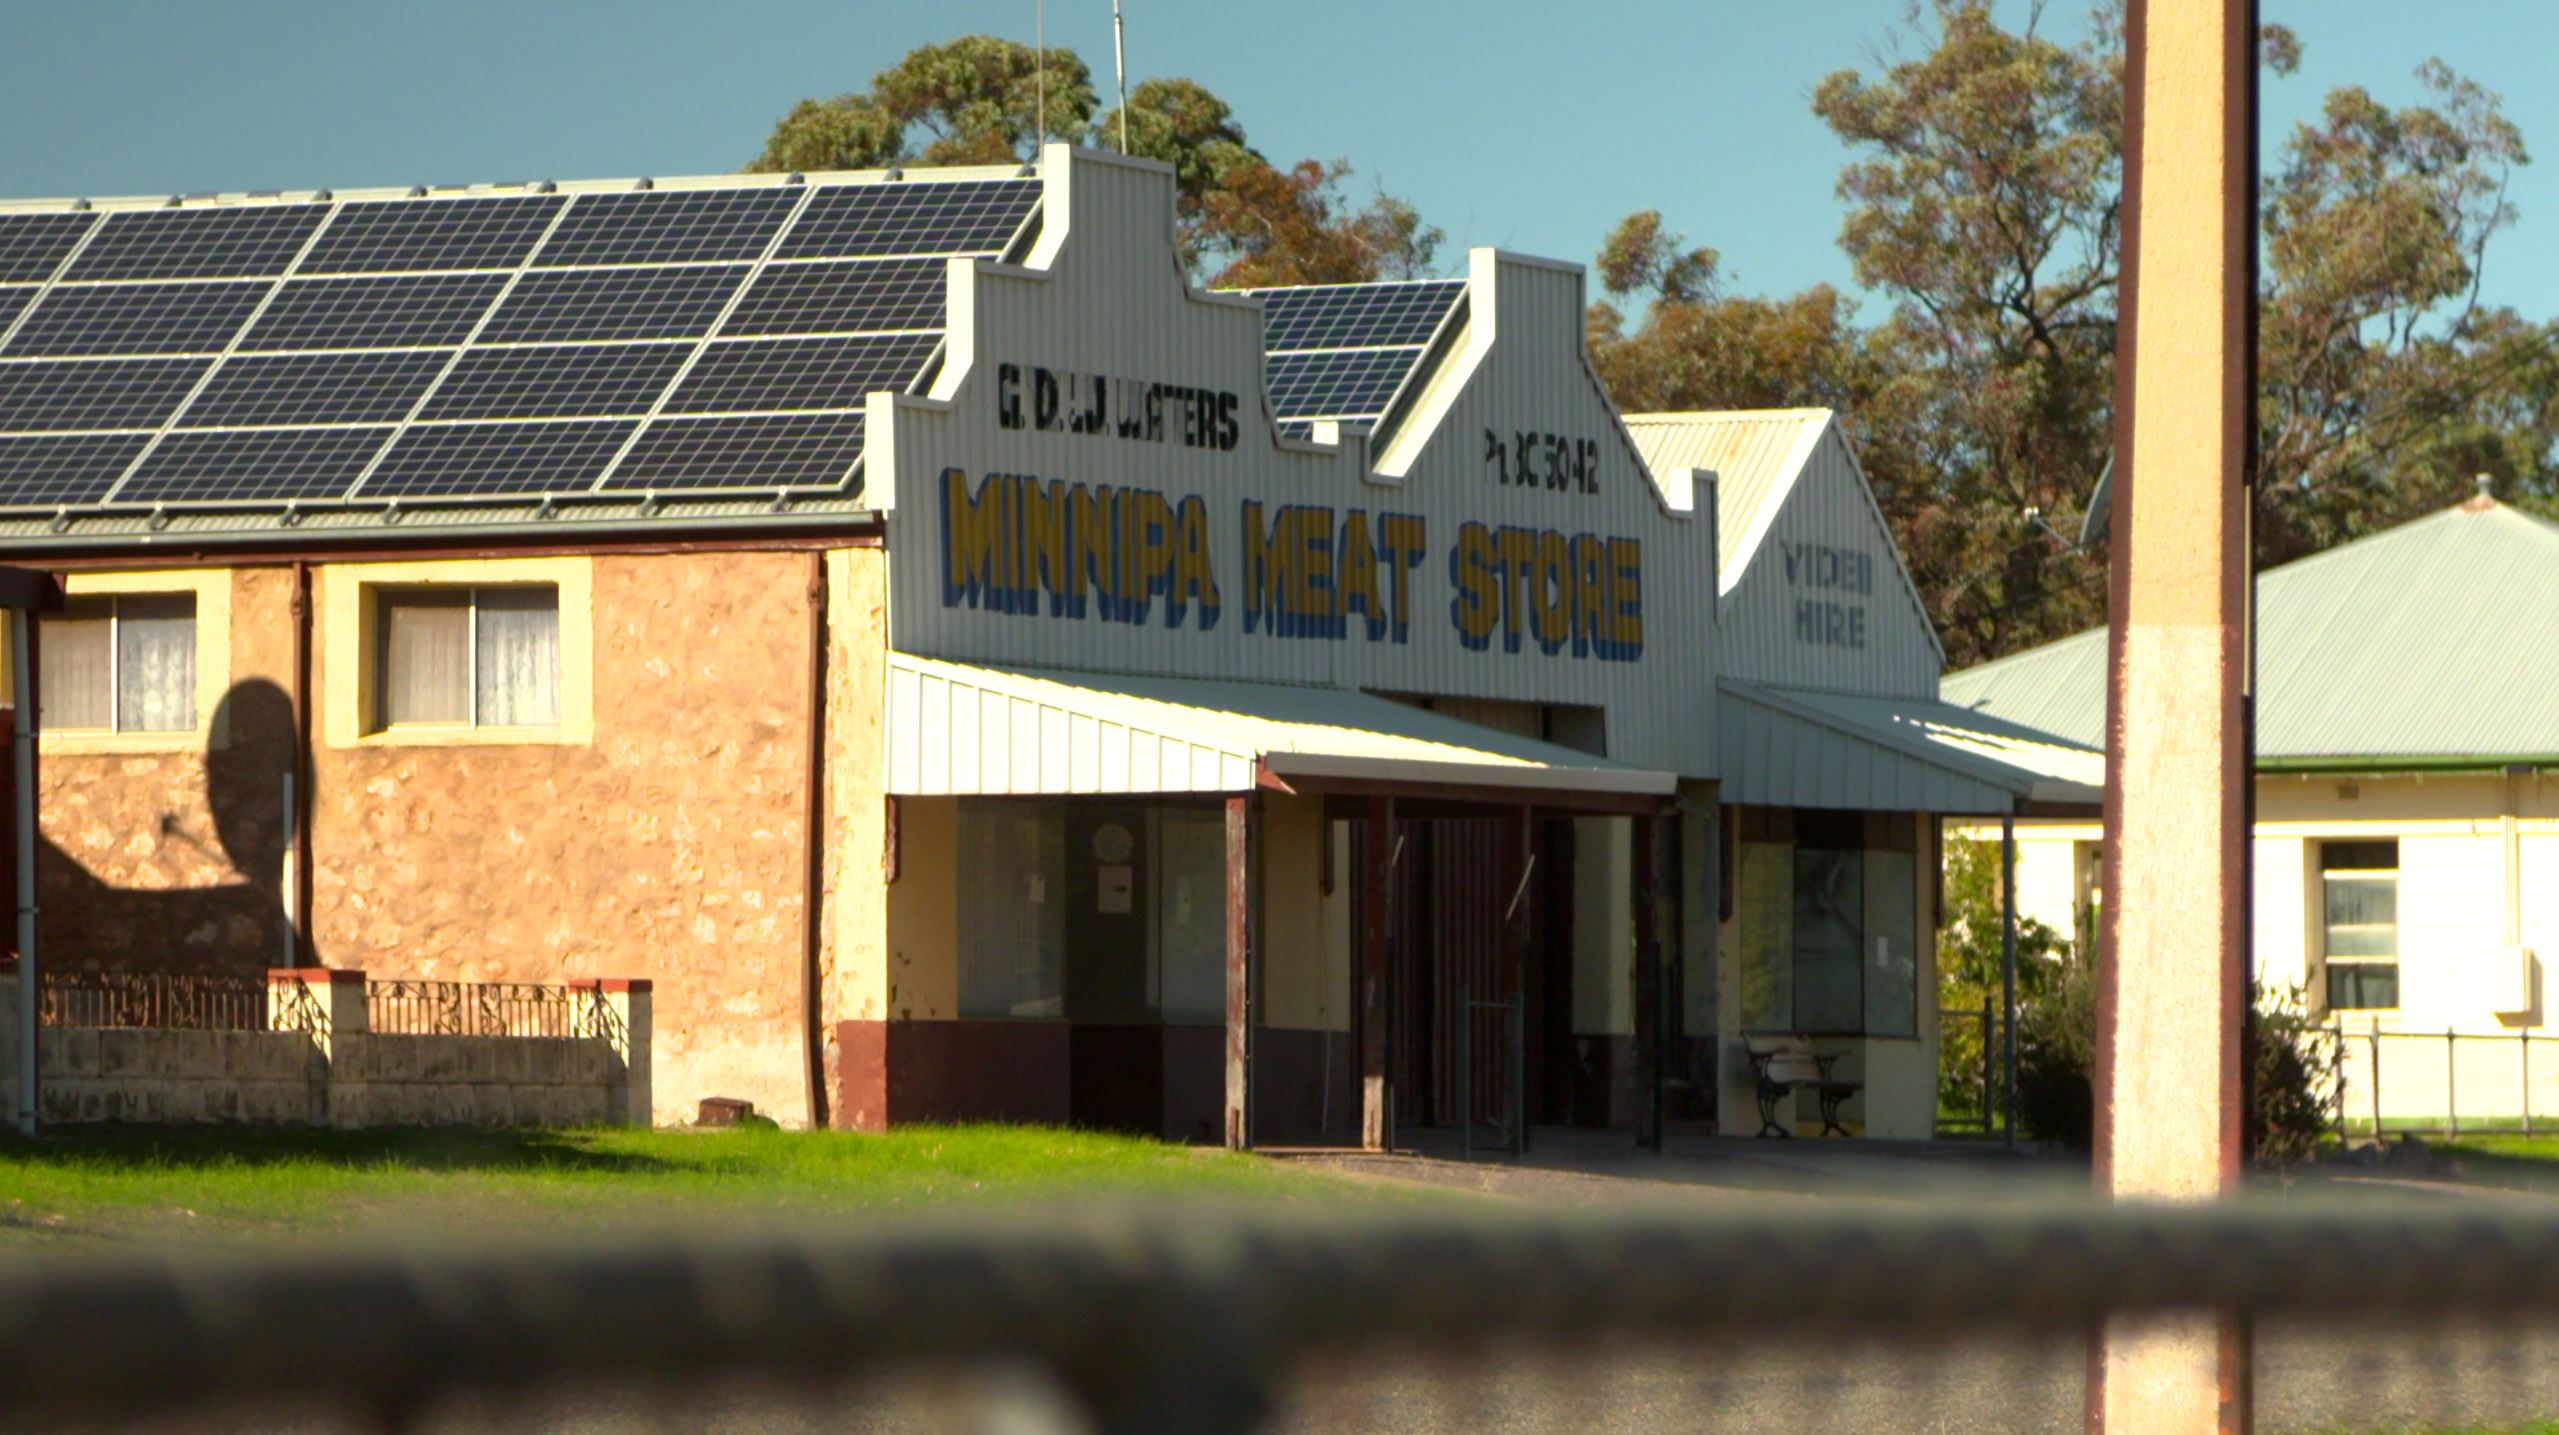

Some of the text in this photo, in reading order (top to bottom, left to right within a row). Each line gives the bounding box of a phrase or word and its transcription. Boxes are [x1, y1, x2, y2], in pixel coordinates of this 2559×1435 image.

[939, 466, 1644, 662] MINNIPA MEAT STORE
[1778, 540, 1873, 597] VIDEO
[1796, 599, 1865, 651] HIRE
